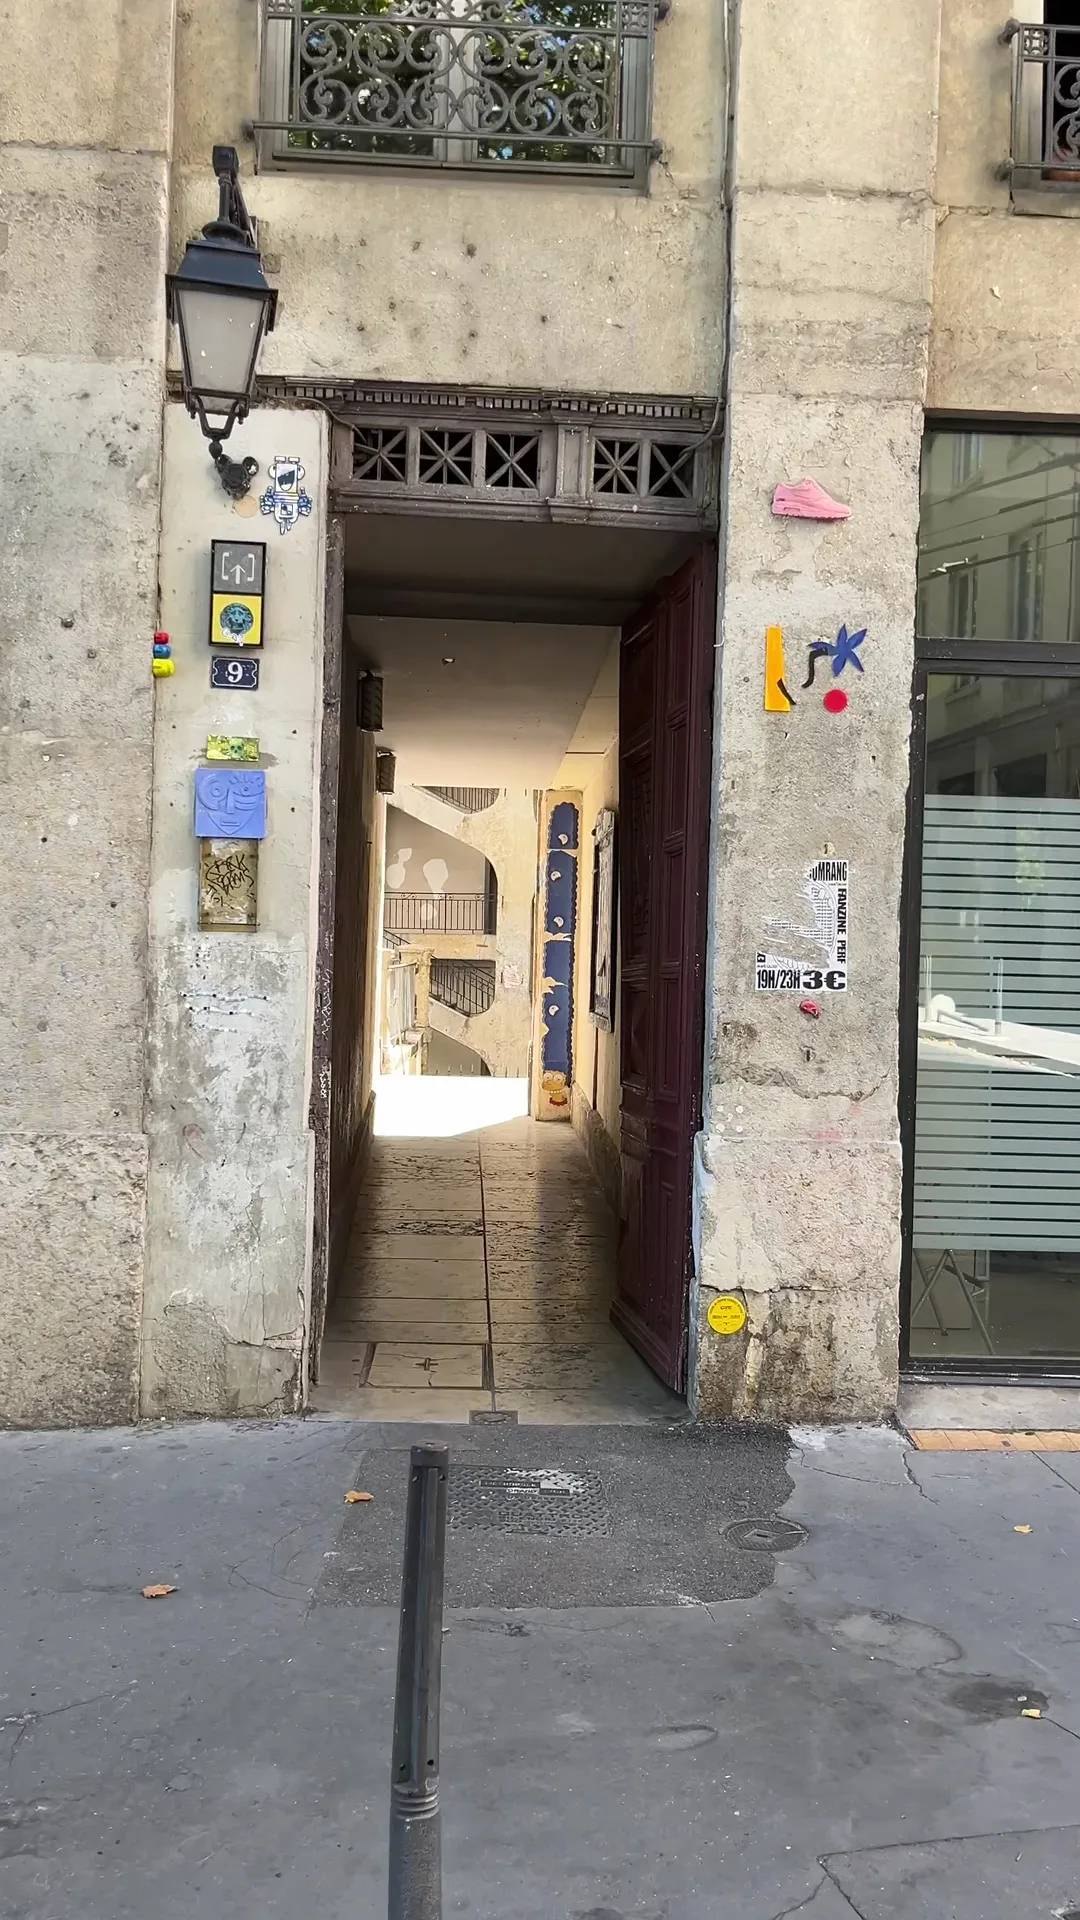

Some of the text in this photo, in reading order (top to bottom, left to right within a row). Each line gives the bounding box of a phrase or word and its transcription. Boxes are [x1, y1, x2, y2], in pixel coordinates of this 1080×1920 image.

[227, 661, 244, 683] 9
[809, 861, 847, 881] UMRANG
[837, 888, 847, 935] FANZINE
[837, 940, 847, 964] PERF
[757, 969, 846, 990] 19H/23H 3€
